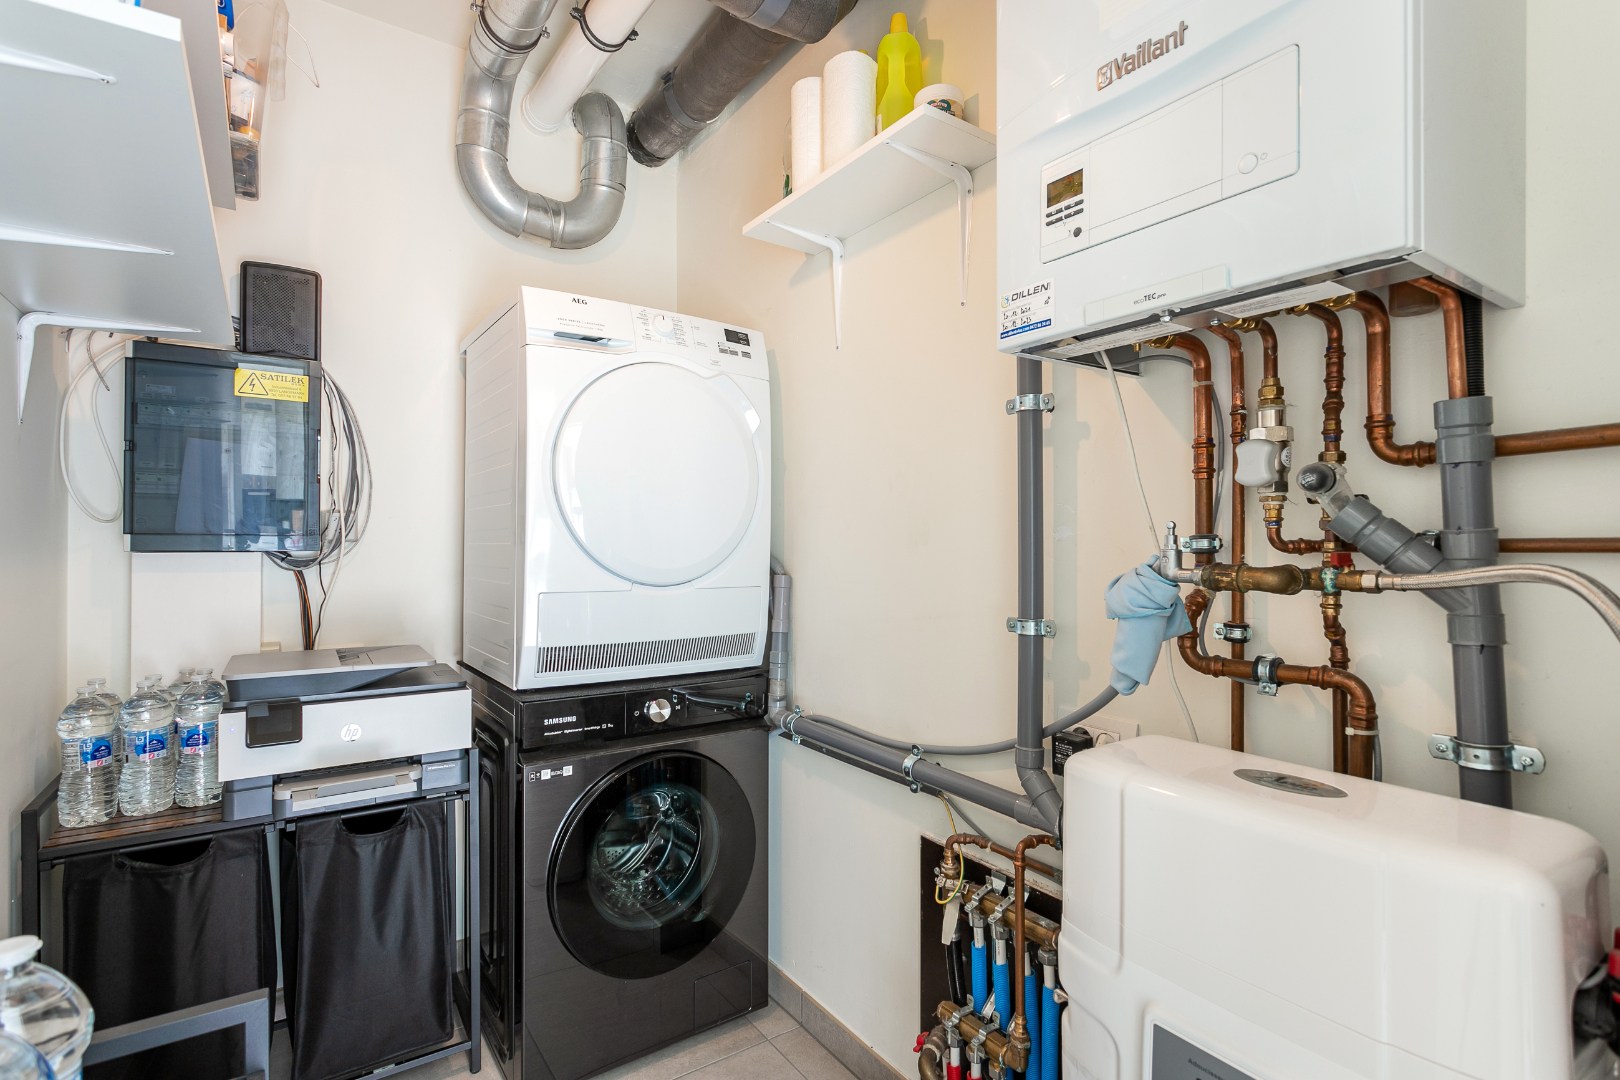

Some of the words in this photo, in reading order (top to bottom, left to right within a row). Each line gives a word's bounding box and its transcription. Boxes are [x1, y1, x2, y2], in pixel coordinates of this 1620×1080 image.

[1113, 20, 1189, 80] Vaillant
[1011, 282, 1049, 301] DILLEN
[571, 297, 588, 305] AEG
[260, 373, 305, 385] SATILEK
[543, 715, 577, 726] SAMSUNG
[344, 725, 359, 741] hp
